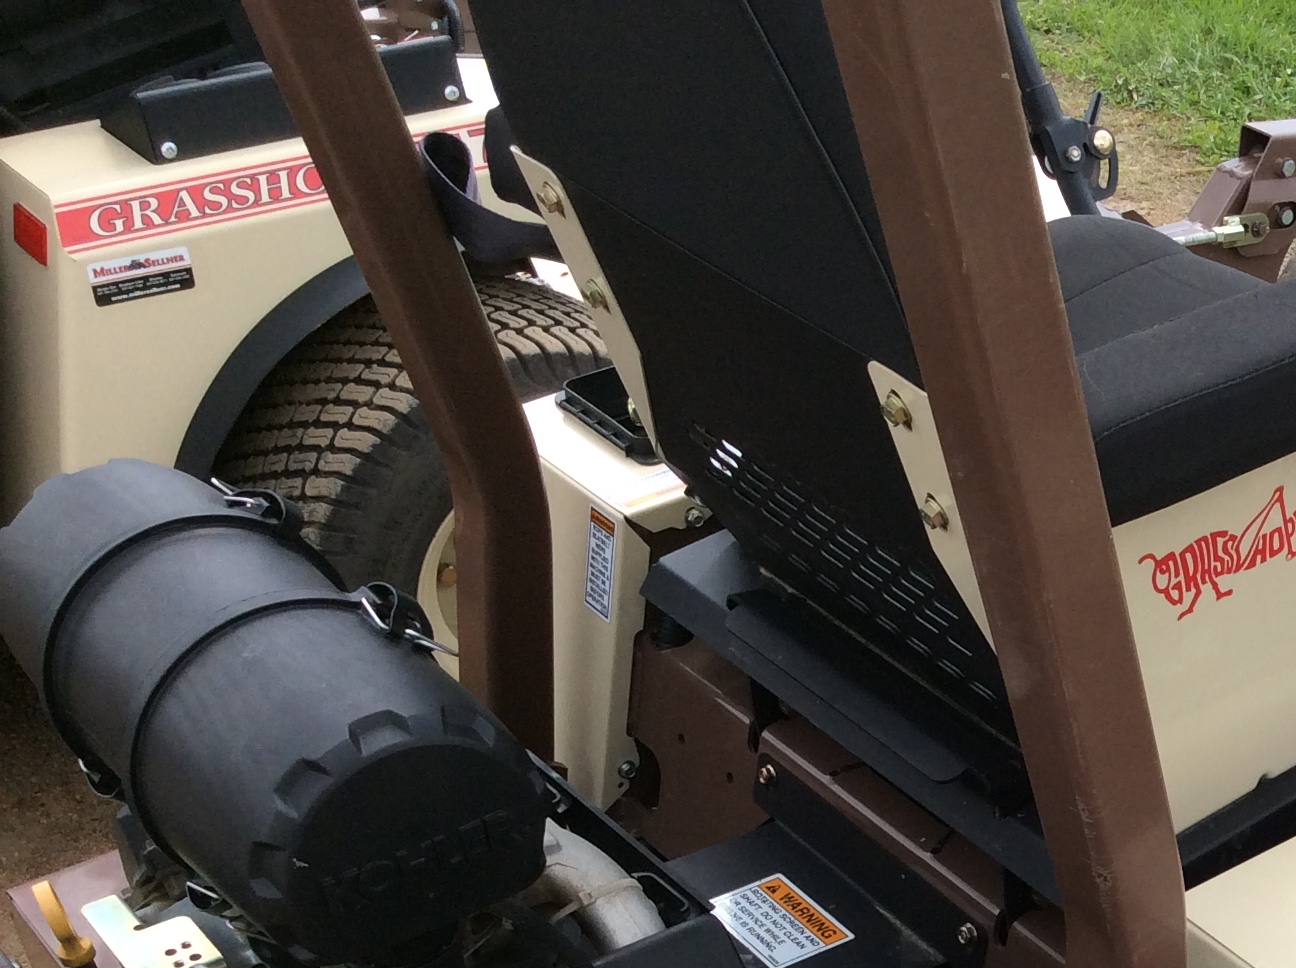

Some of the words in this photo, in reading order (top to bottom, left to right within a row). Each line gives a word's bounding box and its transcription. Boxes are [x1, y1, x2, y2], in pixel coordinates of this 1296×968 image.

[759, 910, 773, 920] DO
[769, 919, 786, 931] NOT
[782, 930, 807, 950] CLEAN
[776, 891, 839, 940] WARNING
